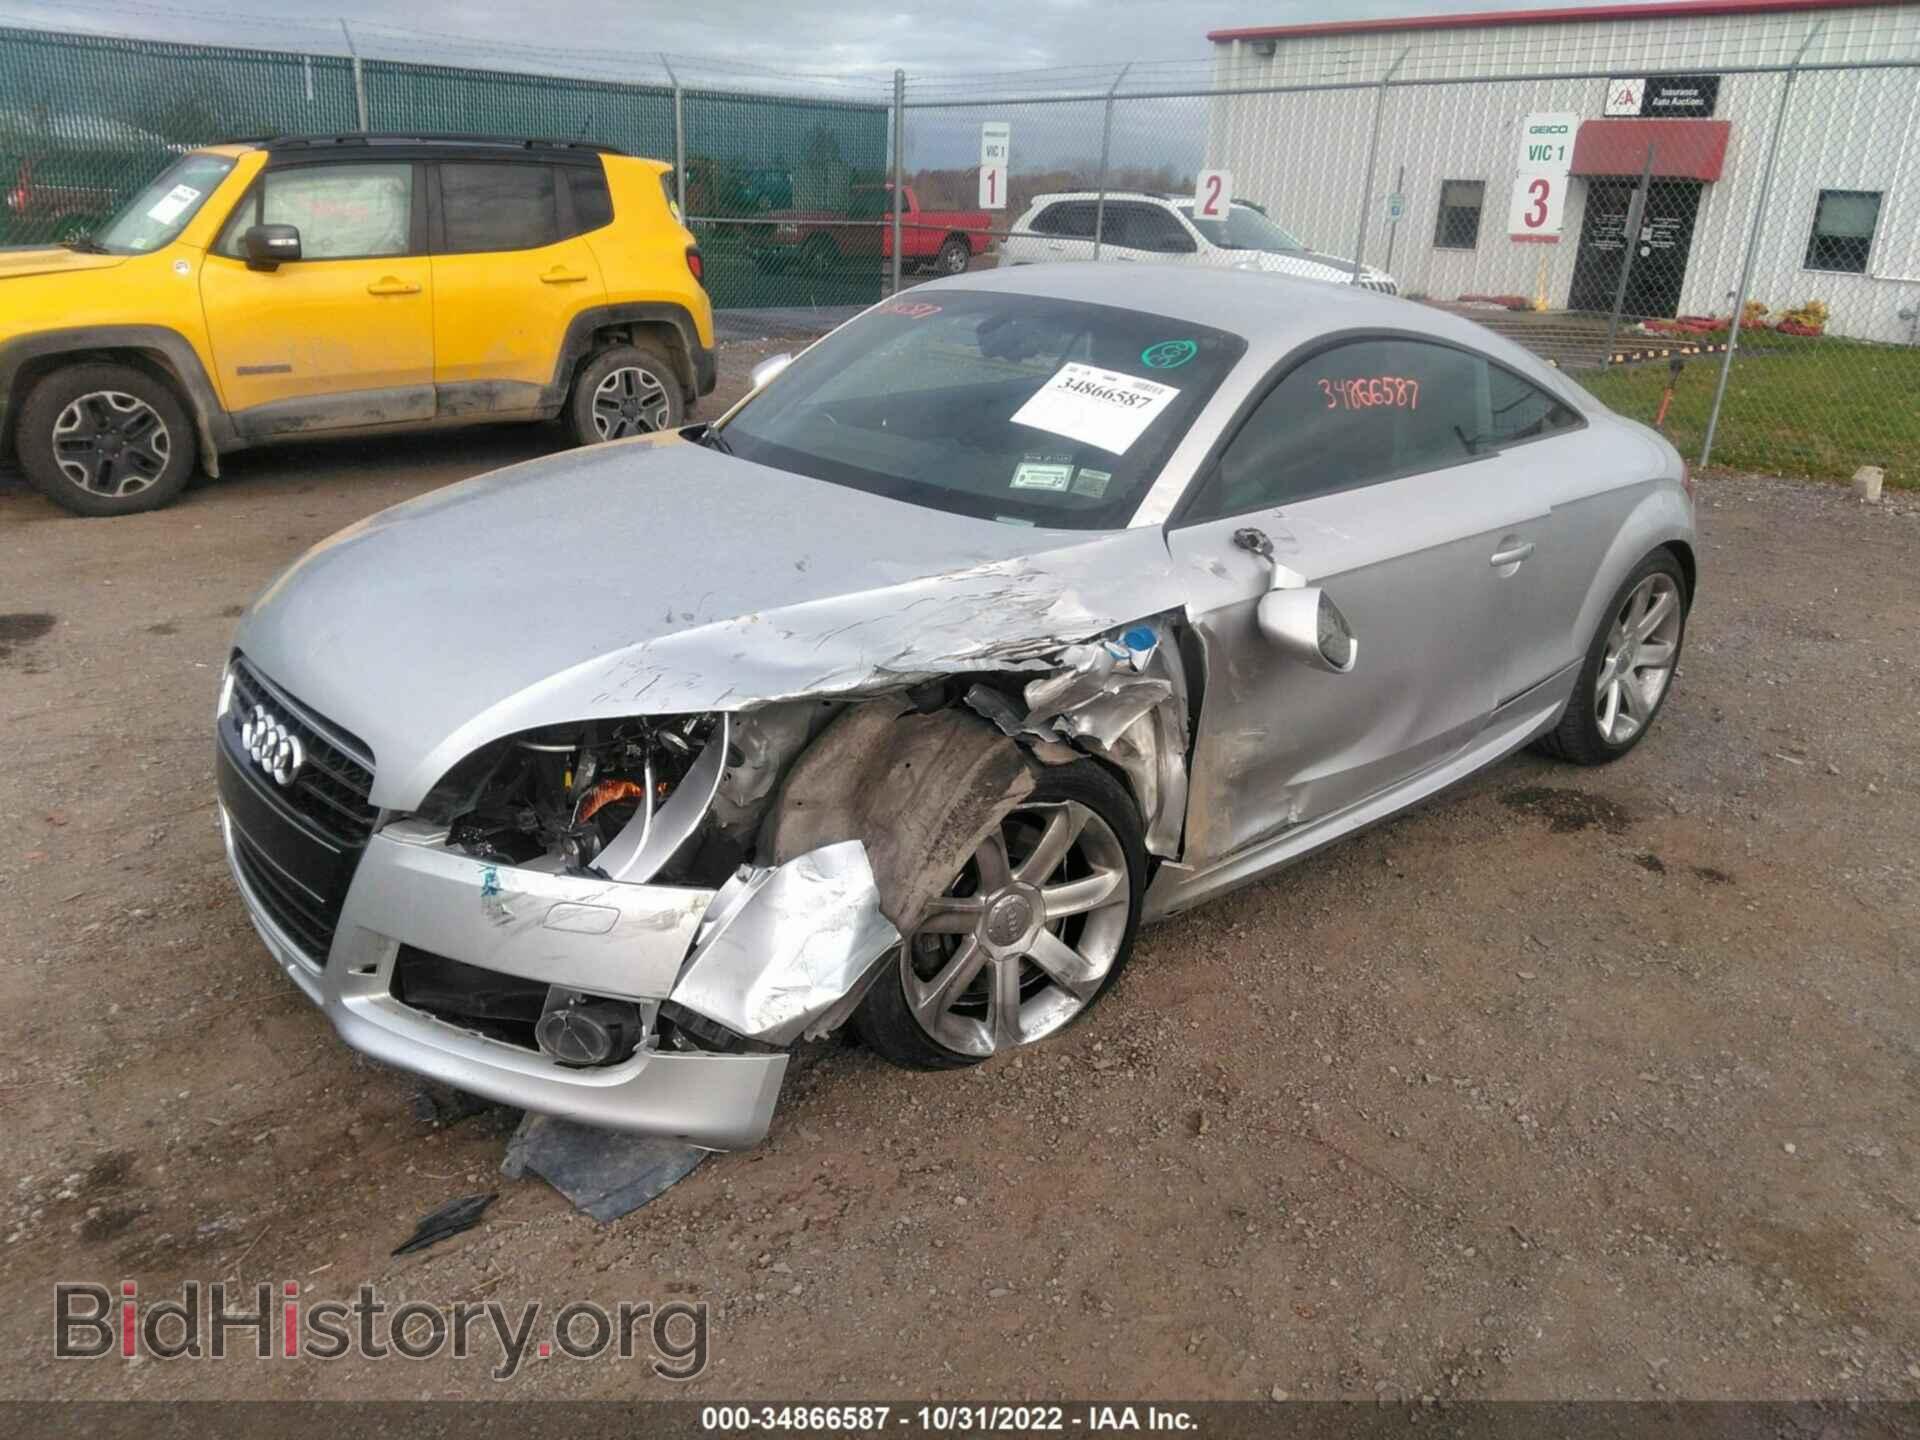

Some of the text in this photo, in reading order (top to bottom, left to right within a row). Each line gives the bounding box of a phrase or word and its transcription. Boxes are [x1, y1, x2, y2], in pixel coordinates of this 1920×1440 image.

[1652, 97, 1705, 106] Auto Auctions
[1660, 87, 1700, 97] Insurance
[1529, 125, 1568, 134] GEICO
[1529, 145, 1565, 161] VIC 1
[987, 169, 996, 205] 1
[1204, 175, 1221, 216] 2
[1524, 179, 1550, 228] 3
[1057, 377, 1153, 409] 34866587
